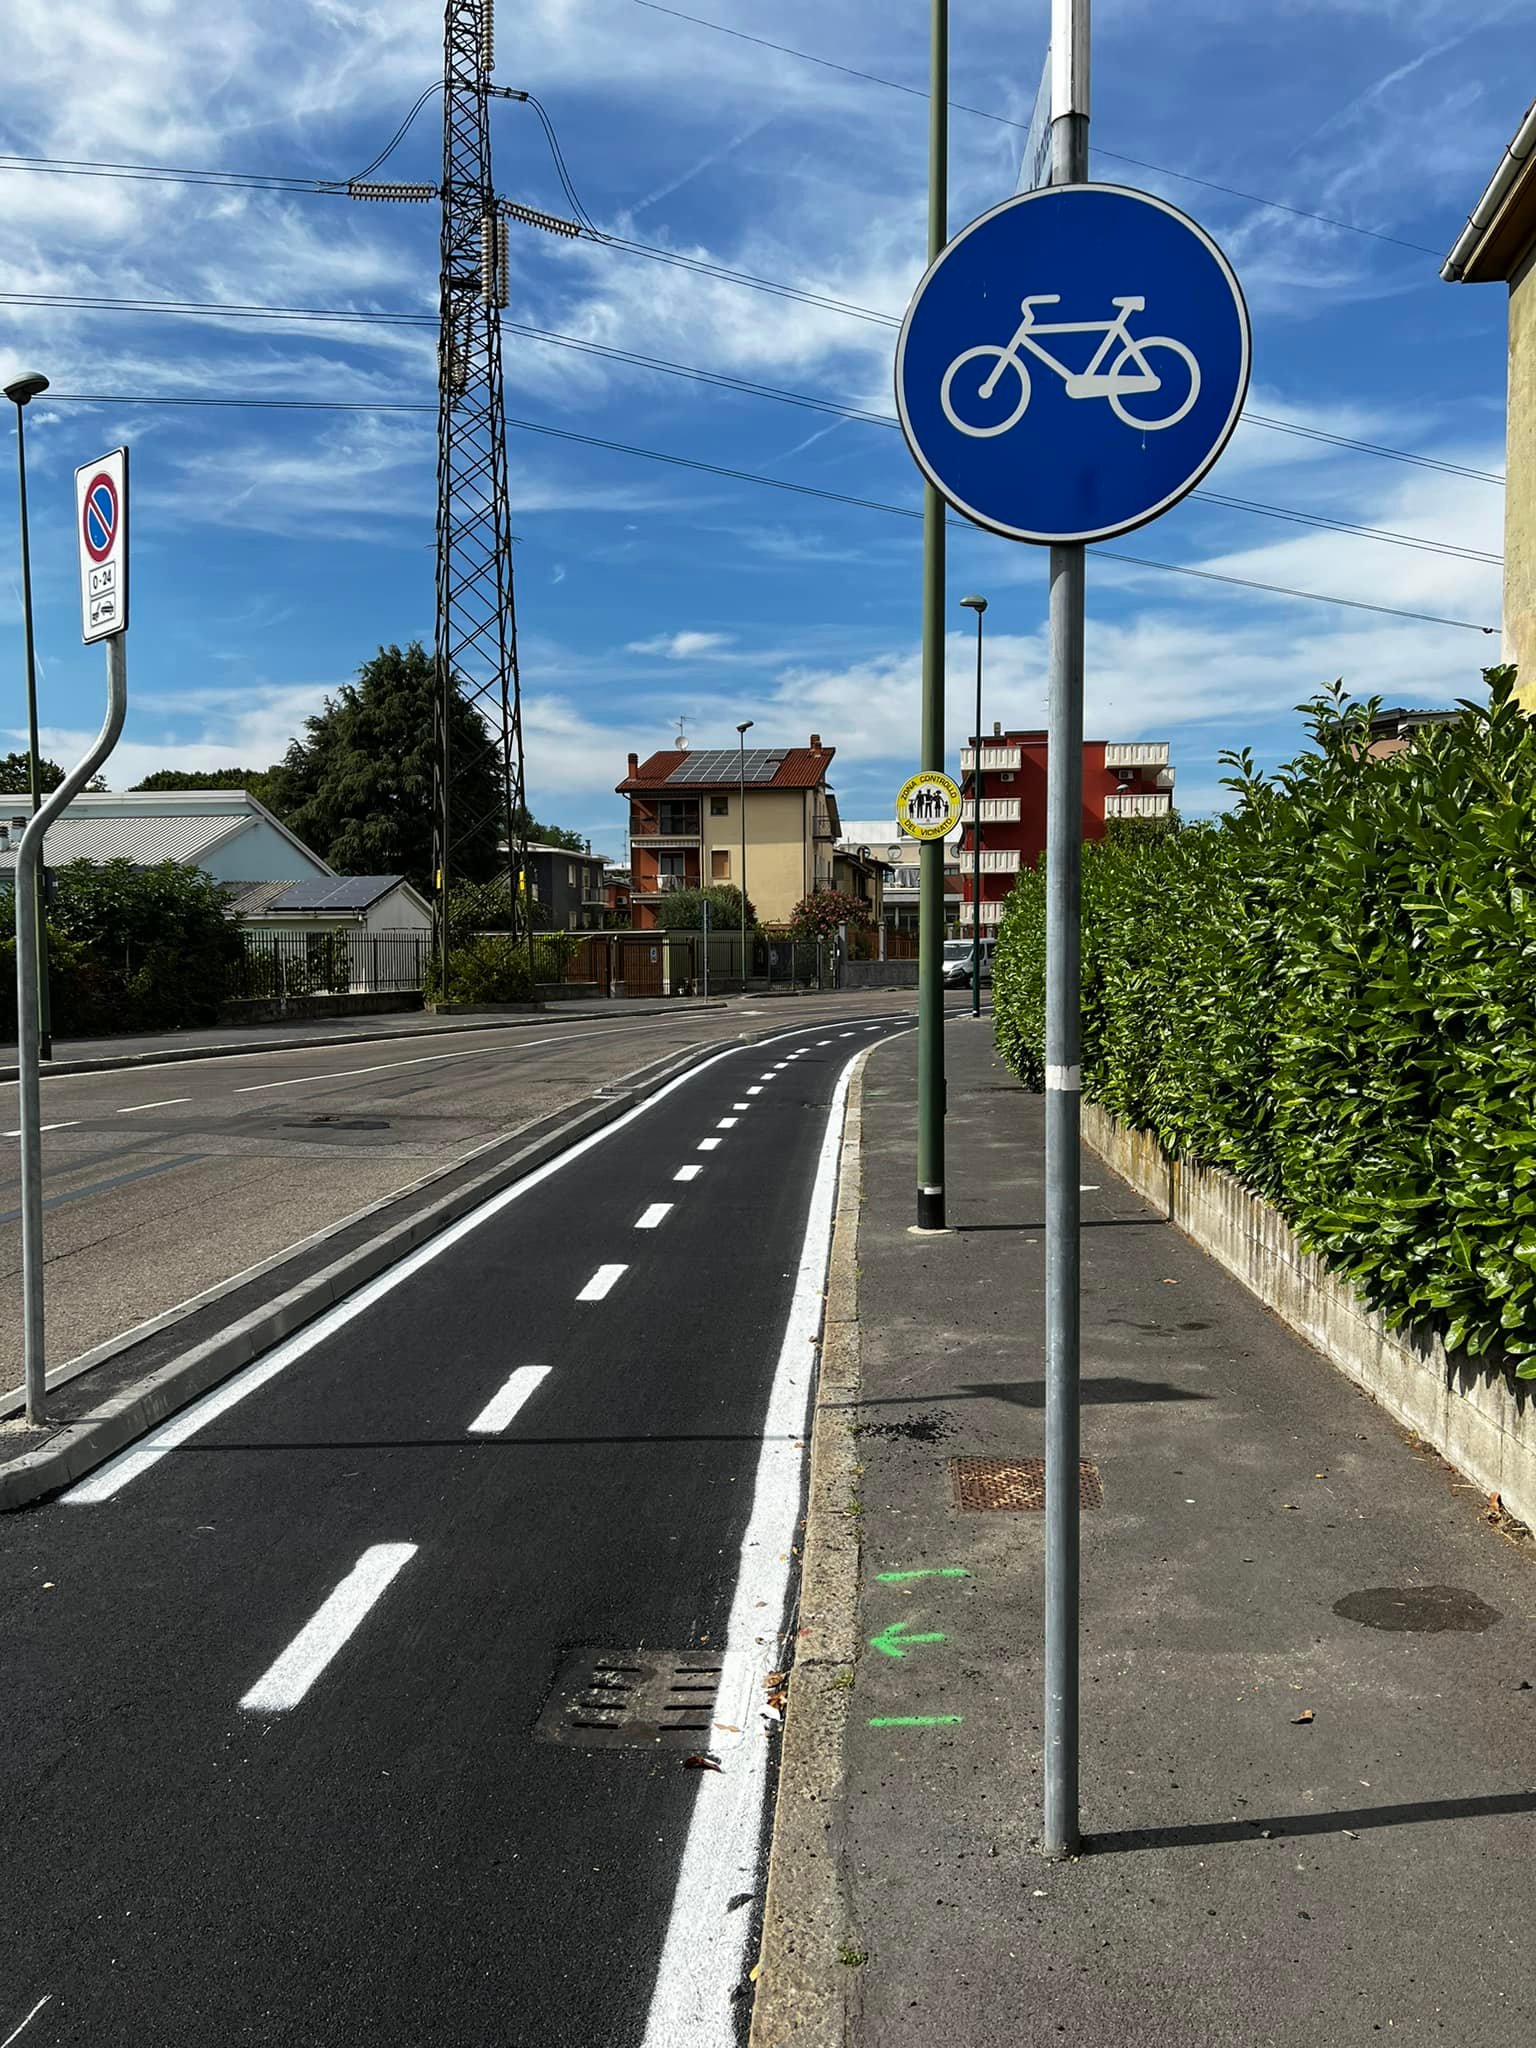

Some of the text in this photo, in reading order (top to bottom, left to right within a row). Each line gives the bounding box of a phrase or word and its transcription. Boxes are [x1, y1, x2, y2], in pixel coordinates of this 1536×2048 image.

[901, 775, 958, 800] ZONA CONTROLLO
[904, 818, 952, 836] DEL VICINATO
